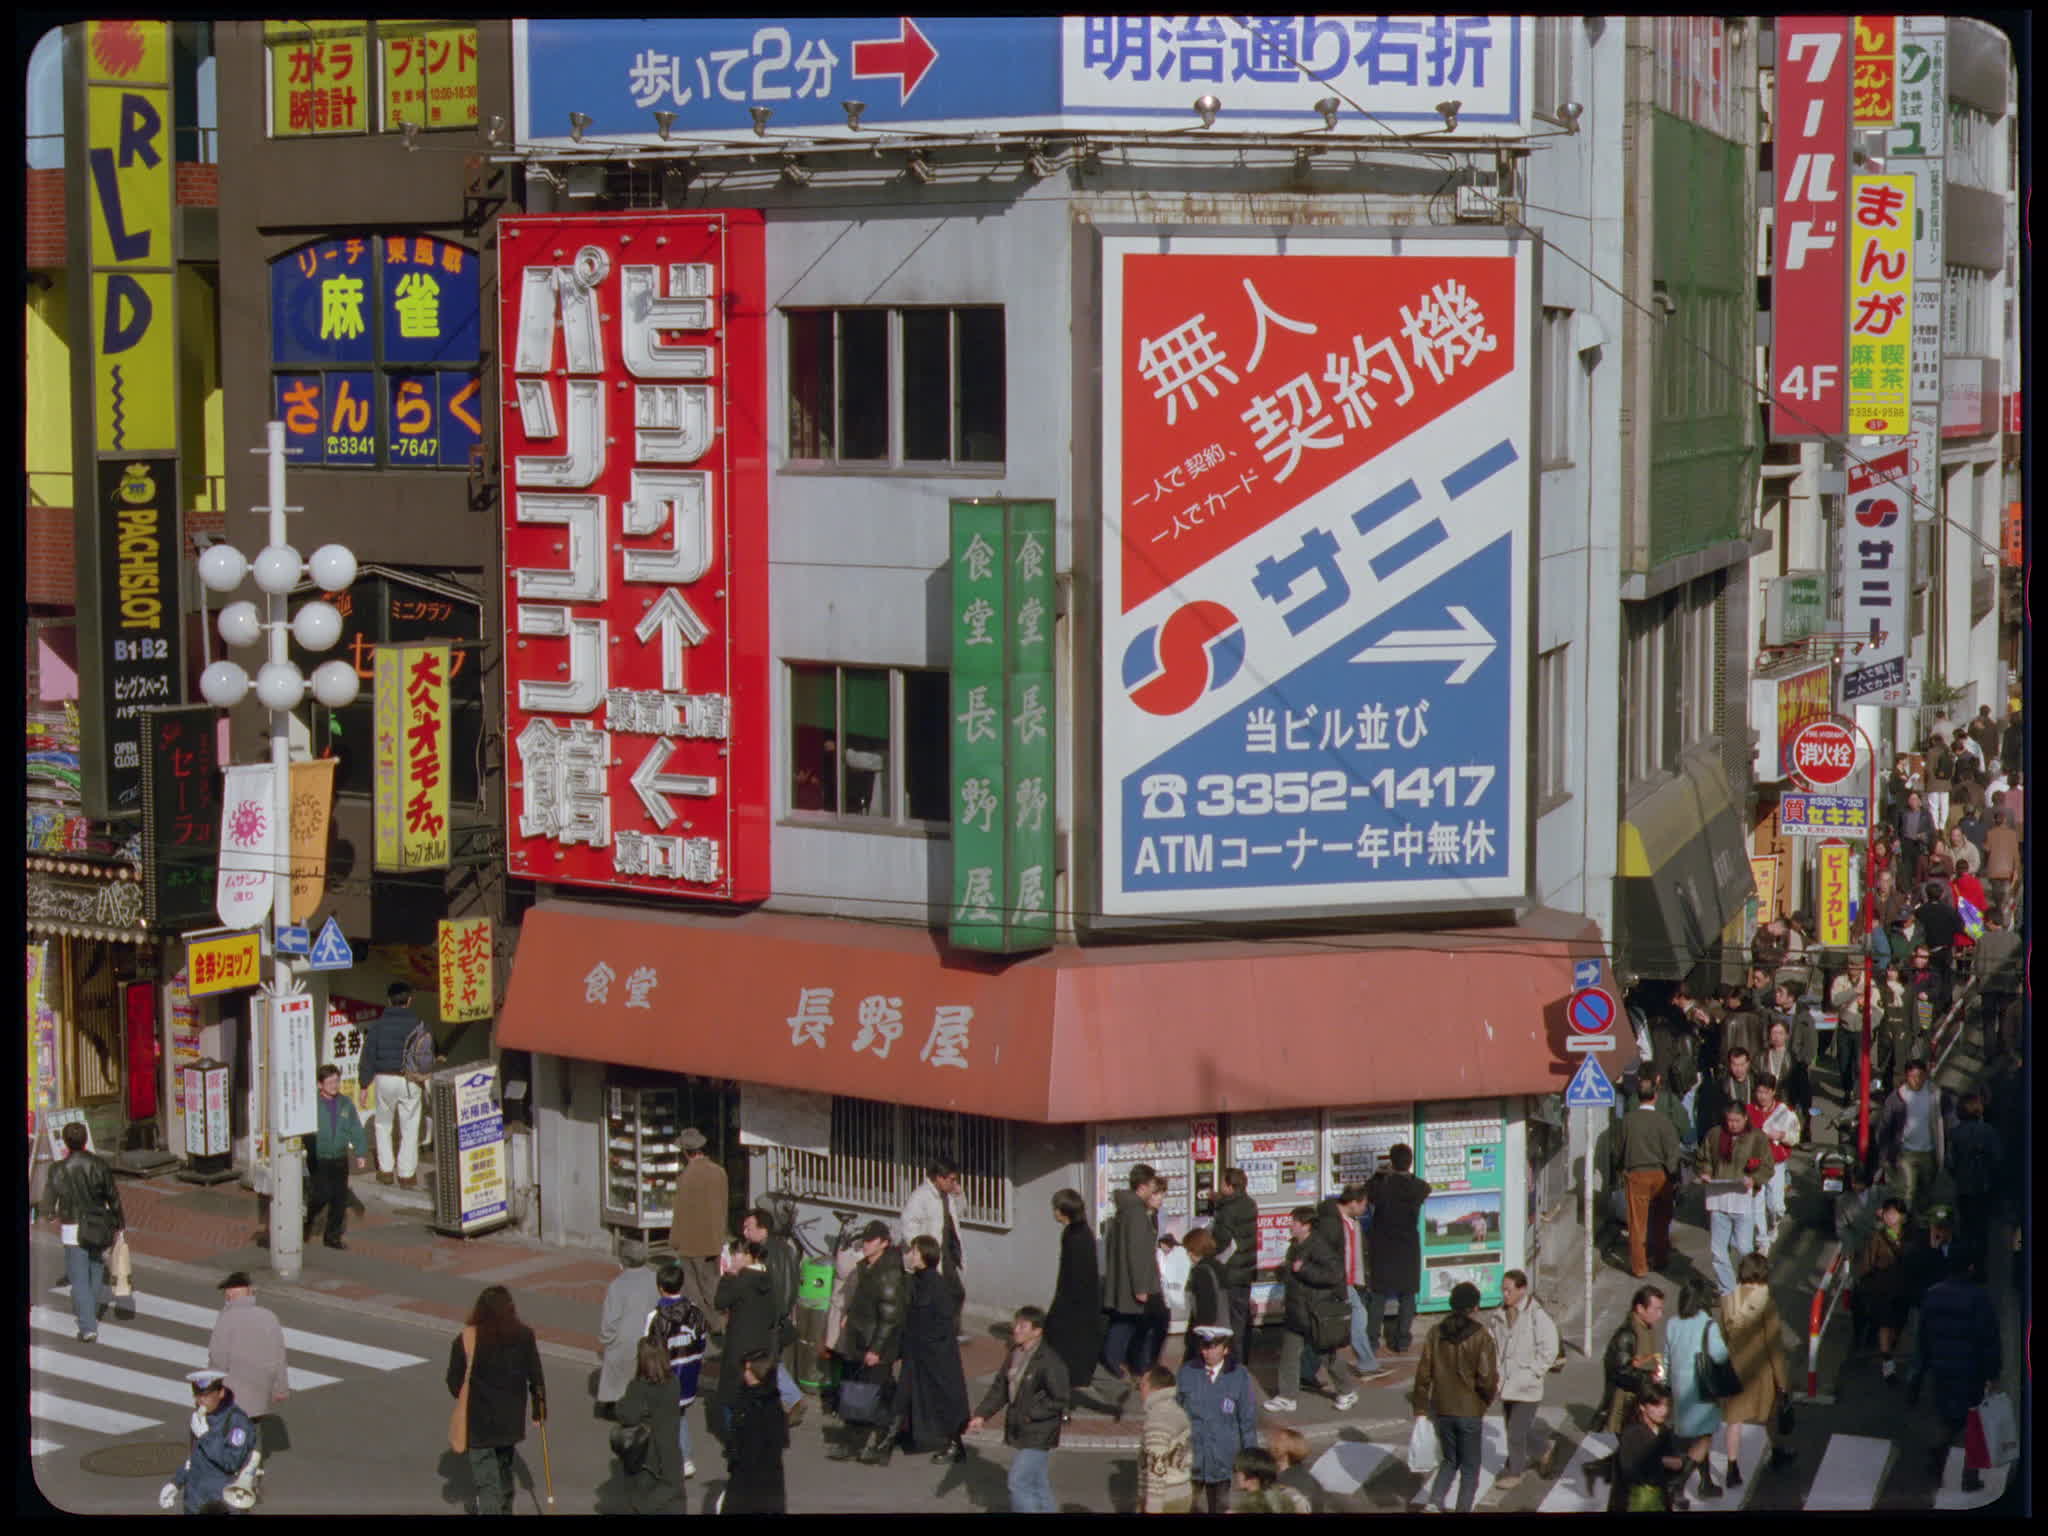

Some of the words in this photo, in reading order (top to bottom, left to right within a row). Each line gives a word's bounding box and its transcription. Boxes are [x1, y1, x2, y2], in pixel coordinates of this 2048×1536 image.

[288, 43, 353, 83] カメラ
[391, 34, 477, 77] ブランド
[629, 27, 839, 107] 歩いて2分
[1083, 17, 1492, 88] 明治通り右折
[289, 86, 358, 129] 腕時計
[1783, 33, 1842, 270] ワールド
[300, 239, 365, 278] リーチ
[1855, 186, 1906, 335] まんが
[320, 272, 441, 340] 麻雀
[1138, 278, 1318, 425] 無人
[1240, 279, 1497, 484] 契約機
[1780, 365, 1838, 401] 4F
[283, 377, 482, 435] さんらく
[1151, 468, 1260, 543] 一人でカード
[1250, 437, 1520, 638] サニー
[118, 509, 161, 630] PACHISLOT
[961, 533, 995, 645] 食堂
[1015, 532, 1045, 646] 食堂
[406, 651, 444, 839] 大人のオモチャ
[1245, 699, 1431, 753] 当ビル並び
[1800, 742, 1852, 767] 消火栓
[956, 685, 1000, 922] 長野屋
[1012, 685, 1050, 926] 長野屋
[1197, 765, 1496, 817] 3352-1417
[1827, 854, 1843, 940] ビーフカレー
[194, 945, 254, 985] 金券ショップ
[333, 1031, 366, 1058] 金券
[584, 961, 658, 1009] 食堂
[787, 988, 975, 1069] 長野屋
